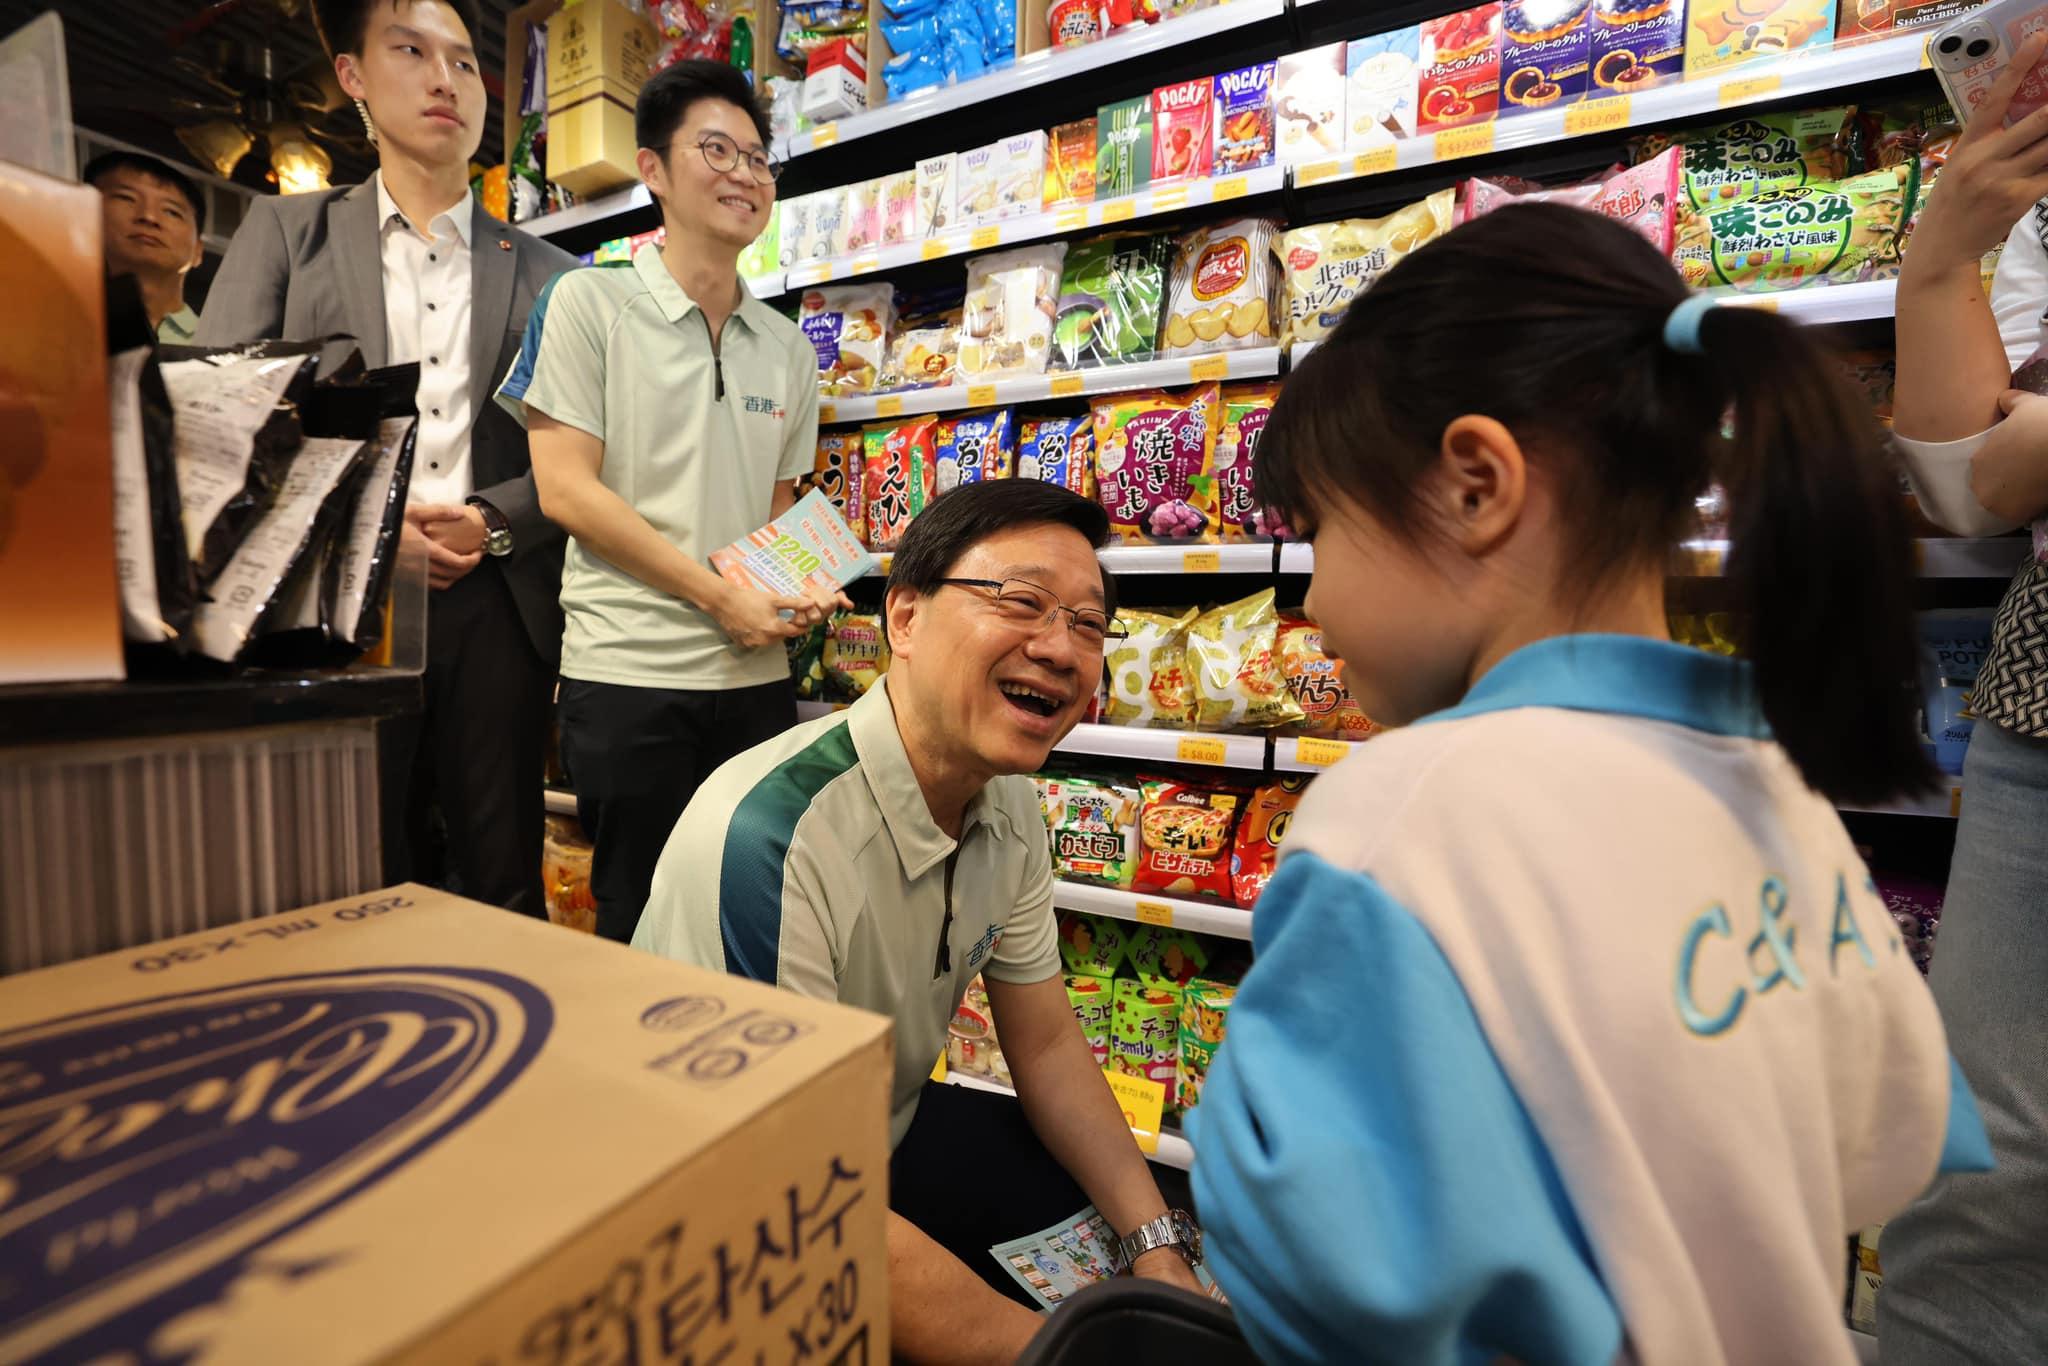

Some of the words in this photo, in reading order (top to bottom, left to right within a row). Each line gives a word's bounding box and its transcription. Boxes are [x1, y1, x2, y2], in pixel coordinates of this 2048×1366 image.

[1896, 3, 1981, 27] SHORTBREAD
[1916, 5, 1934, 16] Pure
[1936, 2, 1961, 12] Butter
[1593, 15, 1681, 43] ブルーベリーのタルト
[1503, 31, 1587, 60] ブルーベリーのタルト
[1423, 50, 1497, 79] いちごのタルト
[1685, 137, 1802, 173] 味ごのみ
[1695, 166, 1798, 187] 鮮烈わさび風味
[1710, 195, 1853, 239] 味ごのみ
[1721, 230, 1839, 254] 鮮烈わさび風味
[1315, 248, 1387, 286] 北海道
[881, 451, 908, 527] えび
[1937, 651, 1982, 665] POT
[1069, 796, 1109, 807] ベビースター
[1176, 792, 1206, 805] Calbee
[1060, 833, 1120, 860] わさビーフ
[1151, 850, 1216, 877] ピザポテト
[1111, 1034, 1154, 1058] Family
